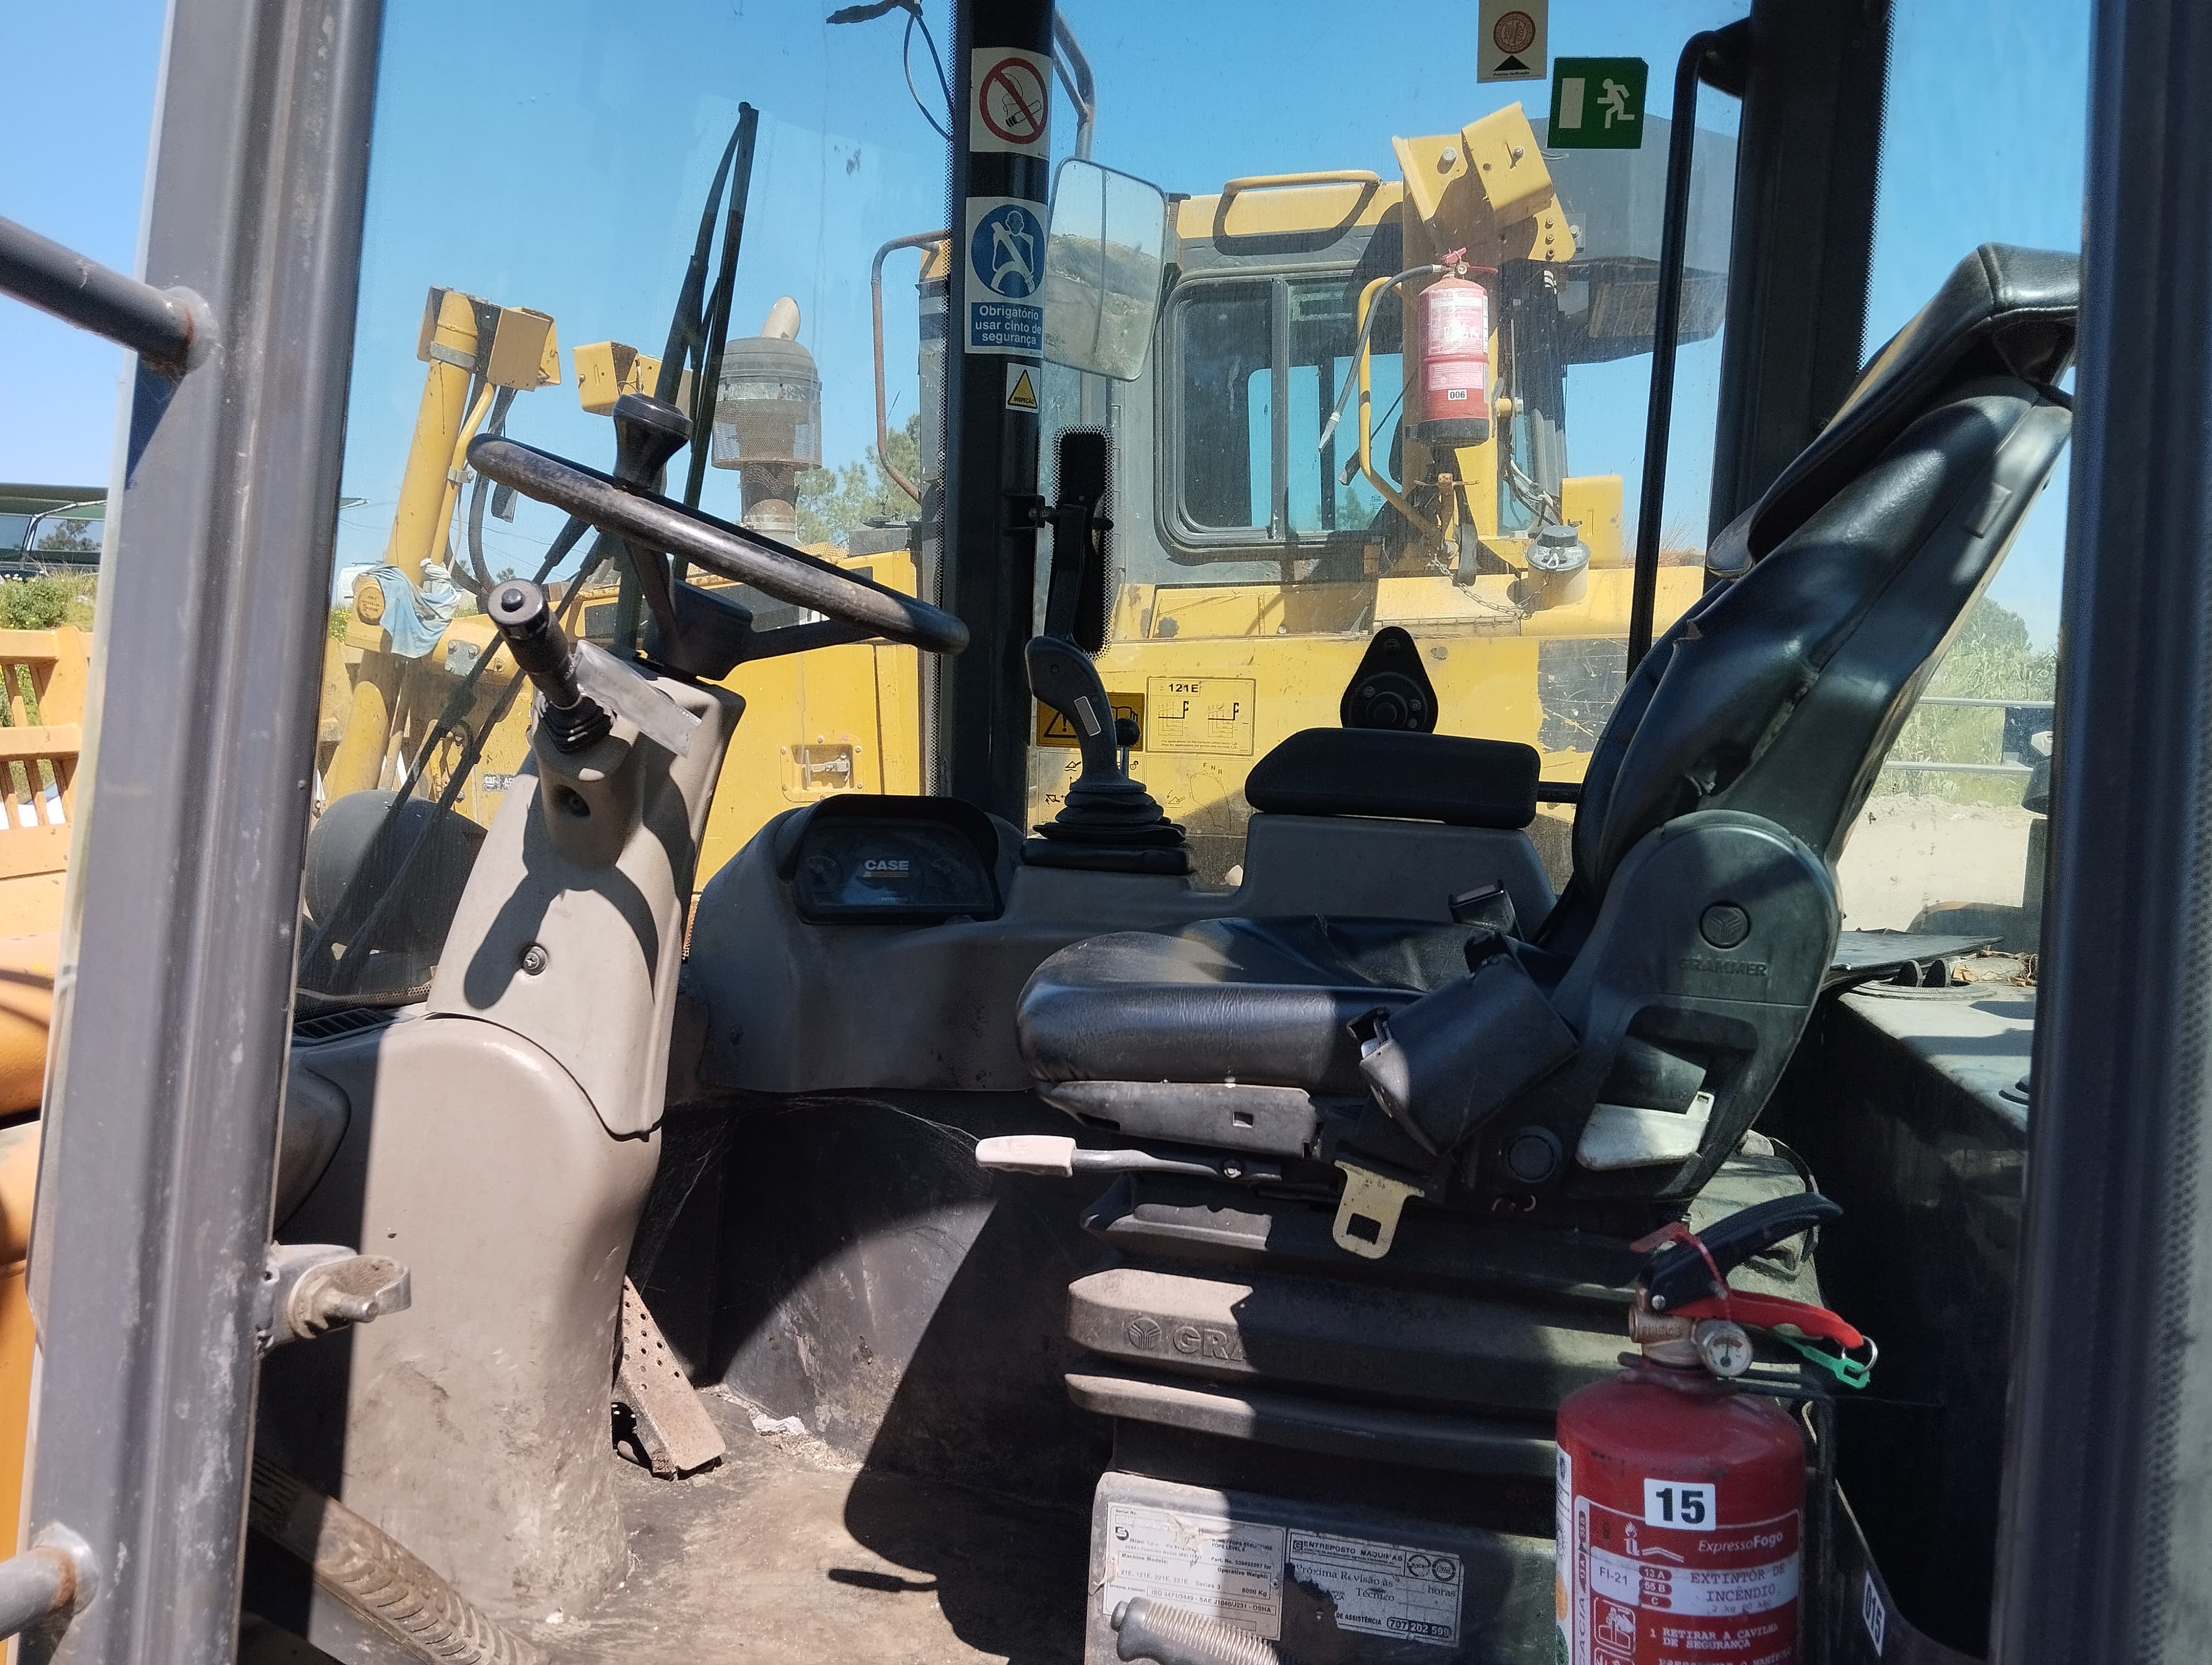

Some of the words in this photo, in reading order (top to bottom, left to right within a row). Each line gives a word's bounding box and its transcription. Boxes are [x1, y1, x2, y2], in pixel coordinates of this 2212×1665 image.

[979, 305, 1039, 320] Obrigatório
[975, 321, 1001, 330] usar
[1005, 321, 1030, 333] cinto
[1032, 324, 1041, 335] de
[982, 332, 1036, 347] segurança
[1168, 683, 1199, 692] 121E
[485, 776, 496, 784] CAT
[865, 860, 909, 871] CASE
[1656, 1488, 1705, 1524] 15
[1303, 1541, 1355, 1554] ENTREPOSTO
[1699, 1532, 1783, 1554] ExpressoFogo
[1122, 1552, 1145, 1561] Machine
[1147, 1556, 1168, 1565] Models:
[1137, 1572, 1153, 1580] 121E,
[1154, 1575, 1171, 1583] 221E,
[1195, 1580, 1215, 1589] Series
[1217, 1567, 1245, 1576] Operative
[1247, 1572, 1268, 1580] Weight:
[1599, 1566, 1628, 1585] FI-21
[1645, 1568, 1655, 1578] 13
[1657, 1570, 1666, 1580] A
[1691, 1568, 1765, 1585] EXTINTOR
[1772, 1564, 1786, 1577] DE
[1258, 1588, 1267, 1597] Kg
[1341, 1572, 1380, 1585] Revisão
[1382, 1576, 1393, 1588] às
[1428, 1584, 1456, 1599] horas
[1645, 1580, 1656, 1591] 55
[1658, 1582, 1666, 1593] B
[1706, 1584, 1776, 1603] INCÊNDIO
[1164, 1591, 1194, 1602] 3471/3449
[1252, 1604, 1271, 1613] OSHA
[1652, 1596, 1659, 1606] C
[1346, 1613, 1381, 1626] ASSISTÊNCIA
[1389, 1619, 1407, 1629] 707
[1411, 1622, 1429, 1634] 202
[1650, 1628, 1657, 1639] 1
[1662, 1628, 1716, 1641] RETIRAR
[1723, 1631, 1731, 1640] A
[1737, 1622, 1779, 1639] CAVILHA
[1663, 1637, 1679, 1647] DE
[1686, 1639, 1752, 1651] SEGURANÇA
